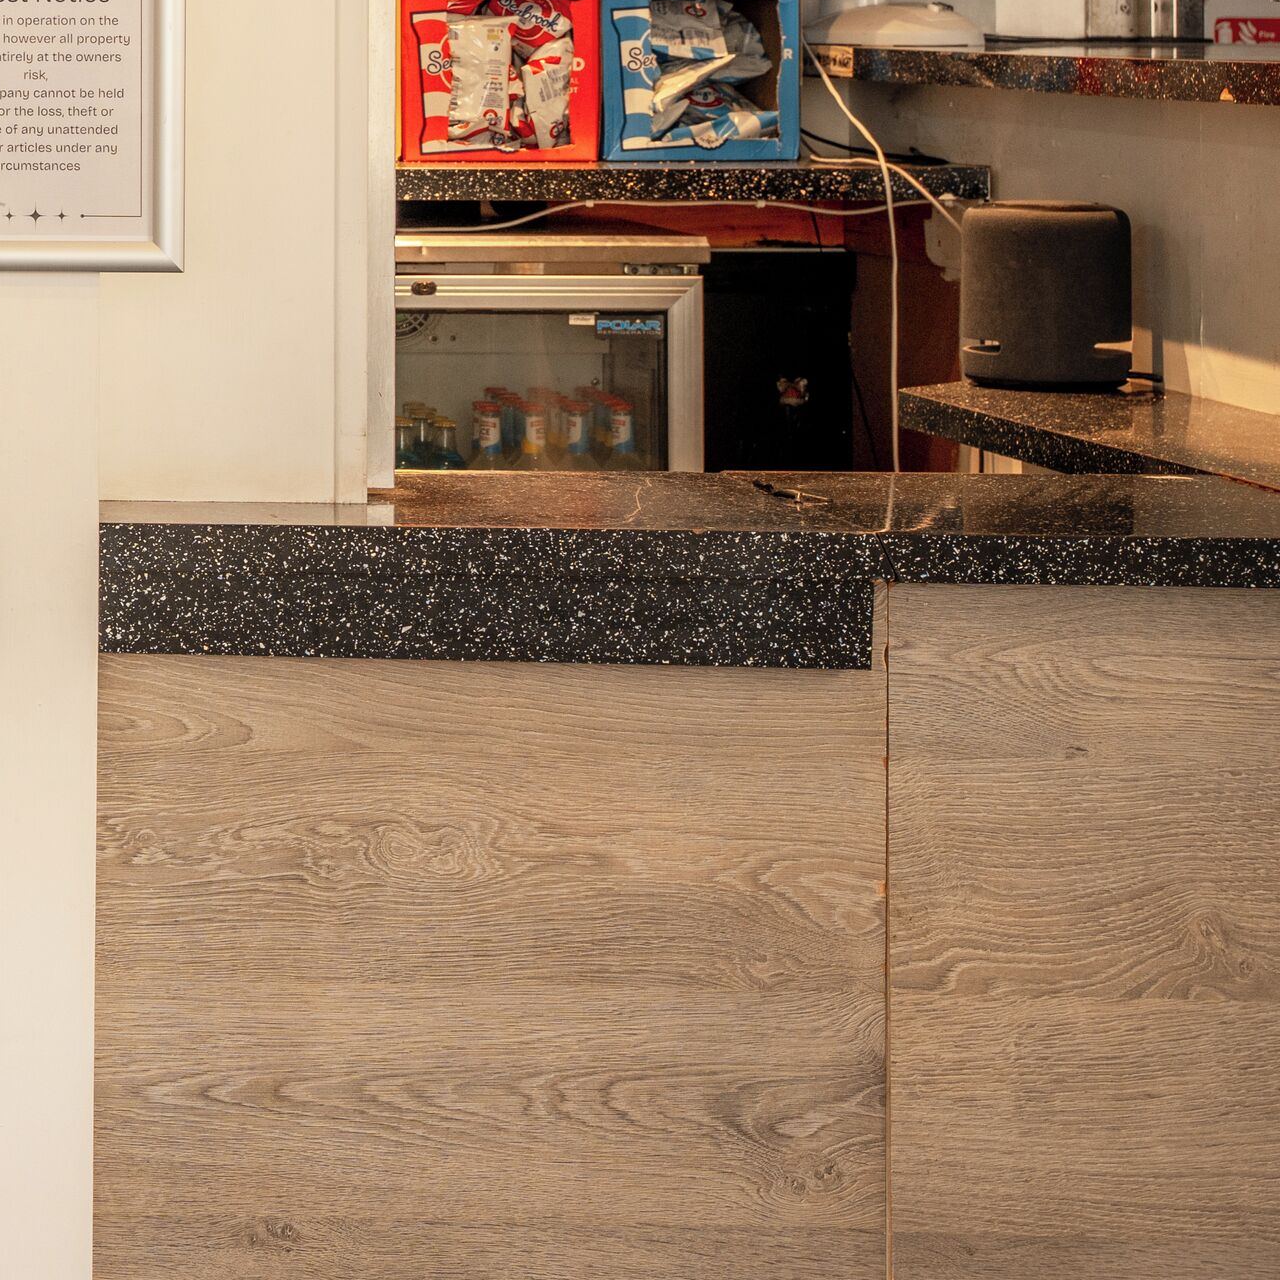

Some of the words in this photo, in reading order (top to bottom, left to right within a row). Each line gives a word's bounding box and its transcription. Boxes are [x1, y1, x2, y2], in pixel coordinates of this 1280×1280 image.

[3, 15, 13, 25] in
[17, 15, 76, 28] operation
[80, 17, 96, 25] on
[99, 15, 119, 25] the
[3, 33, 56, 44] however
[60, 33, 73, 44] all
[77, 34, 130, 46] property
[37, 52, 49, 62] at
[53, 52, 72, 62] the
[75, 54, 122, 62] owners
[23, 70, 48, 81] risk,
[33, 89, 76, 98] cannot
[79, 88, 94, 98] be
[98, 88, 124, 98] held
[14, 106, 34, 116] the
[37, 106, 65, 118] loss,
[68, 106, 97, 116] theft
[101, 108, 114, 116] or
[6, 124, 18, 134] of
[21, 126, 43, 136] any
[47, 125, 118, 134] unattended
[7, 142, 52, 153] articles
[56, 143, 91, 153] under
[95, 144, 118, 154] any
[597, 319, 660, 330] POLAR
